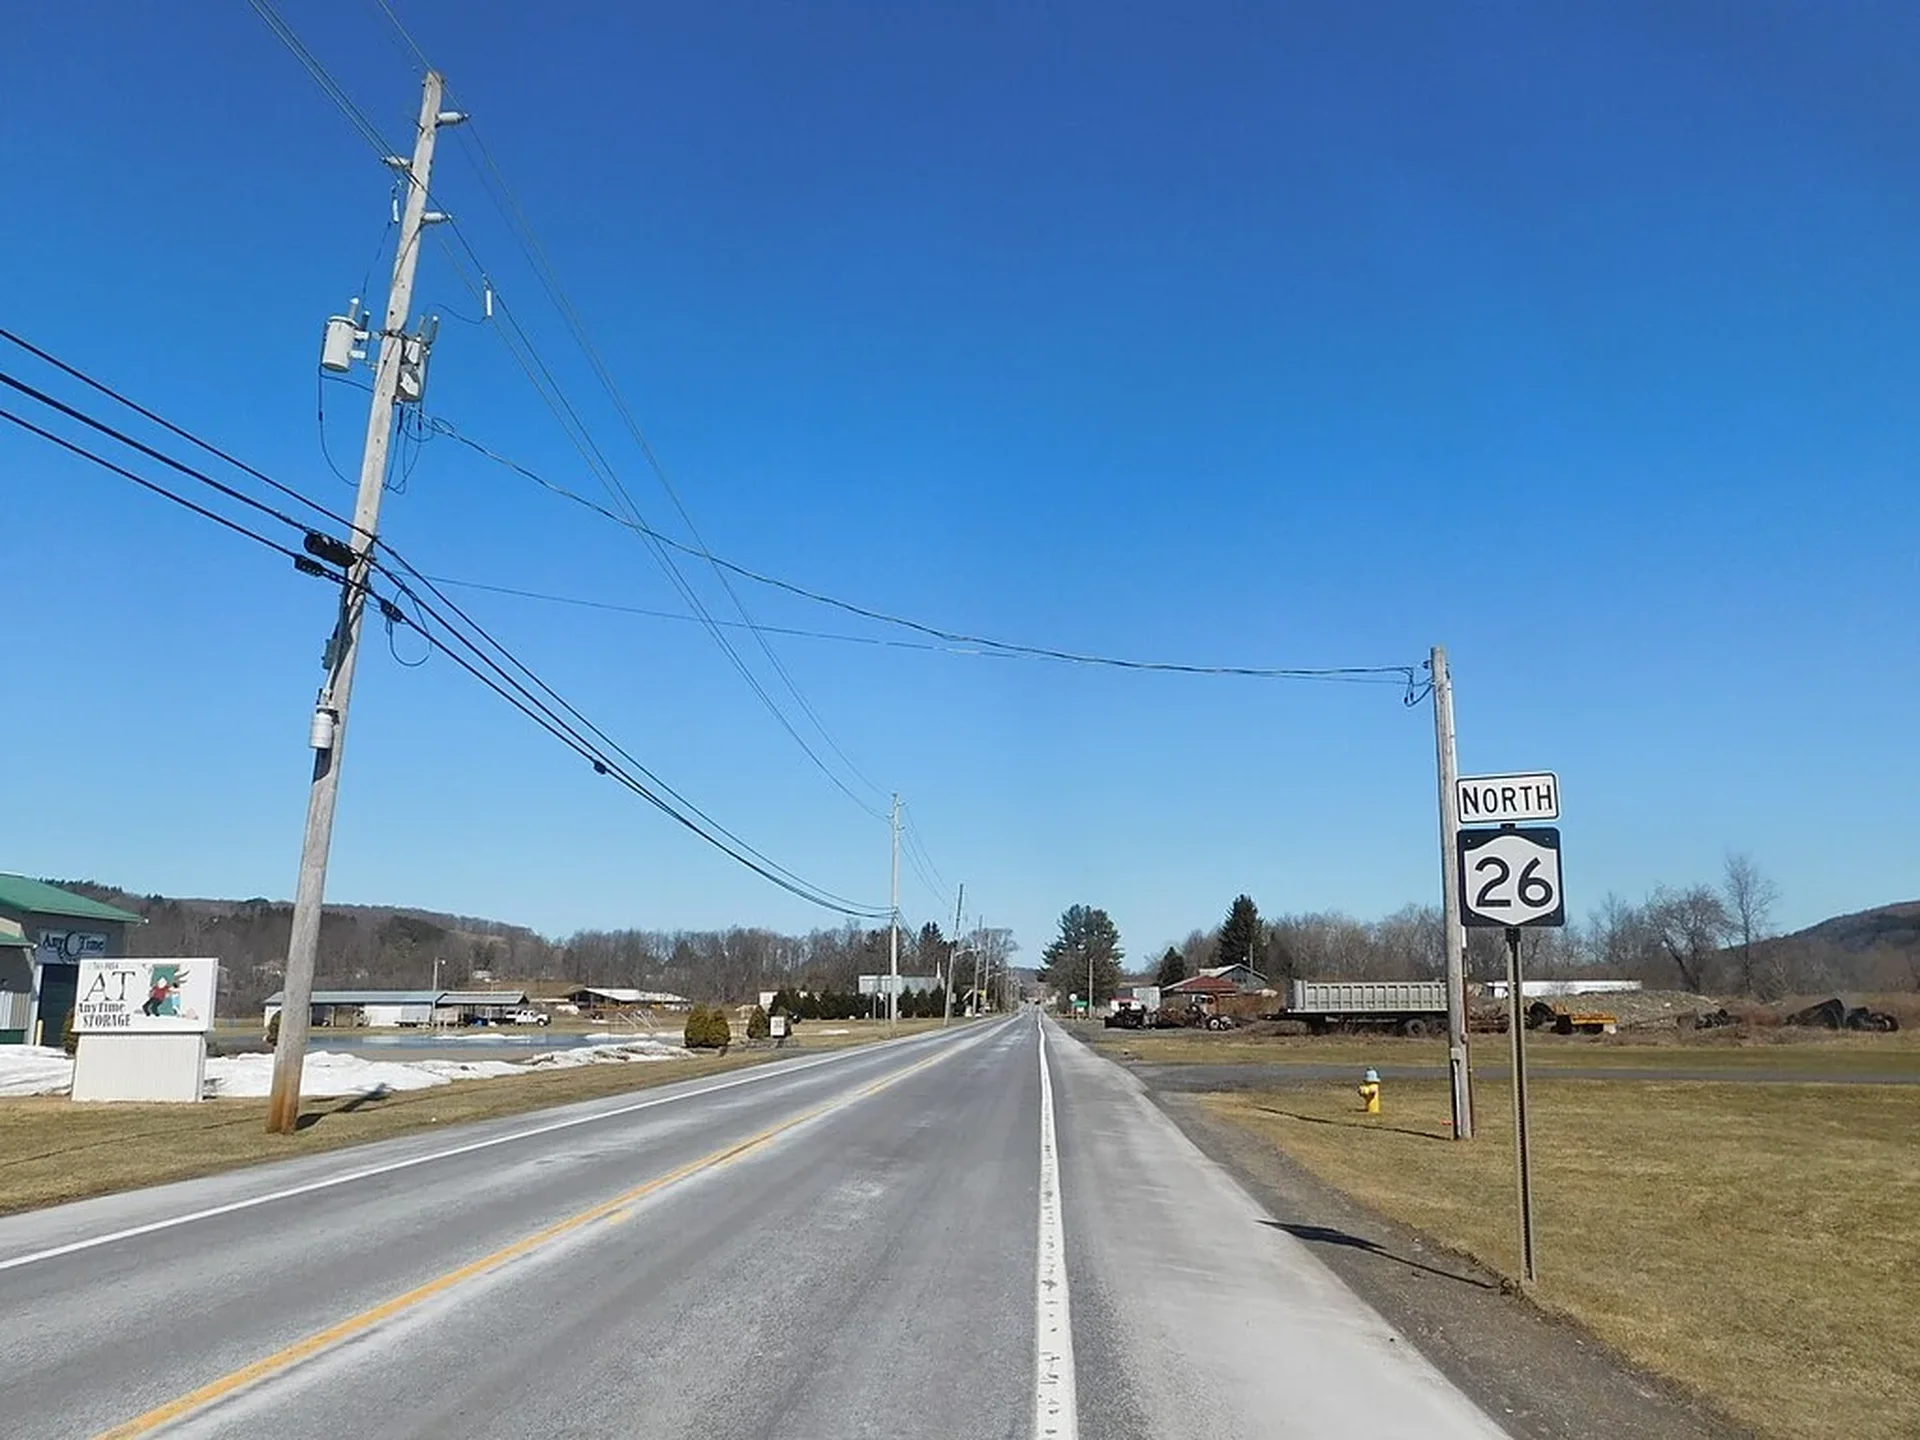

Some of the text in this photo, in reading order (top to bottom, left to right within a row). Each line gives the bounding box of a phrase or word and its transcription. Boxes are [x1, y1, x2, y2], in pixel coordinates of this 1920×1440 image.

[1462, 785, 1553, 814] NORTH
[1475, 856, 1553, 908] 26
[83, 970, 136, 1002] AT
[83, 1014, 131, 1028] STORAGE
